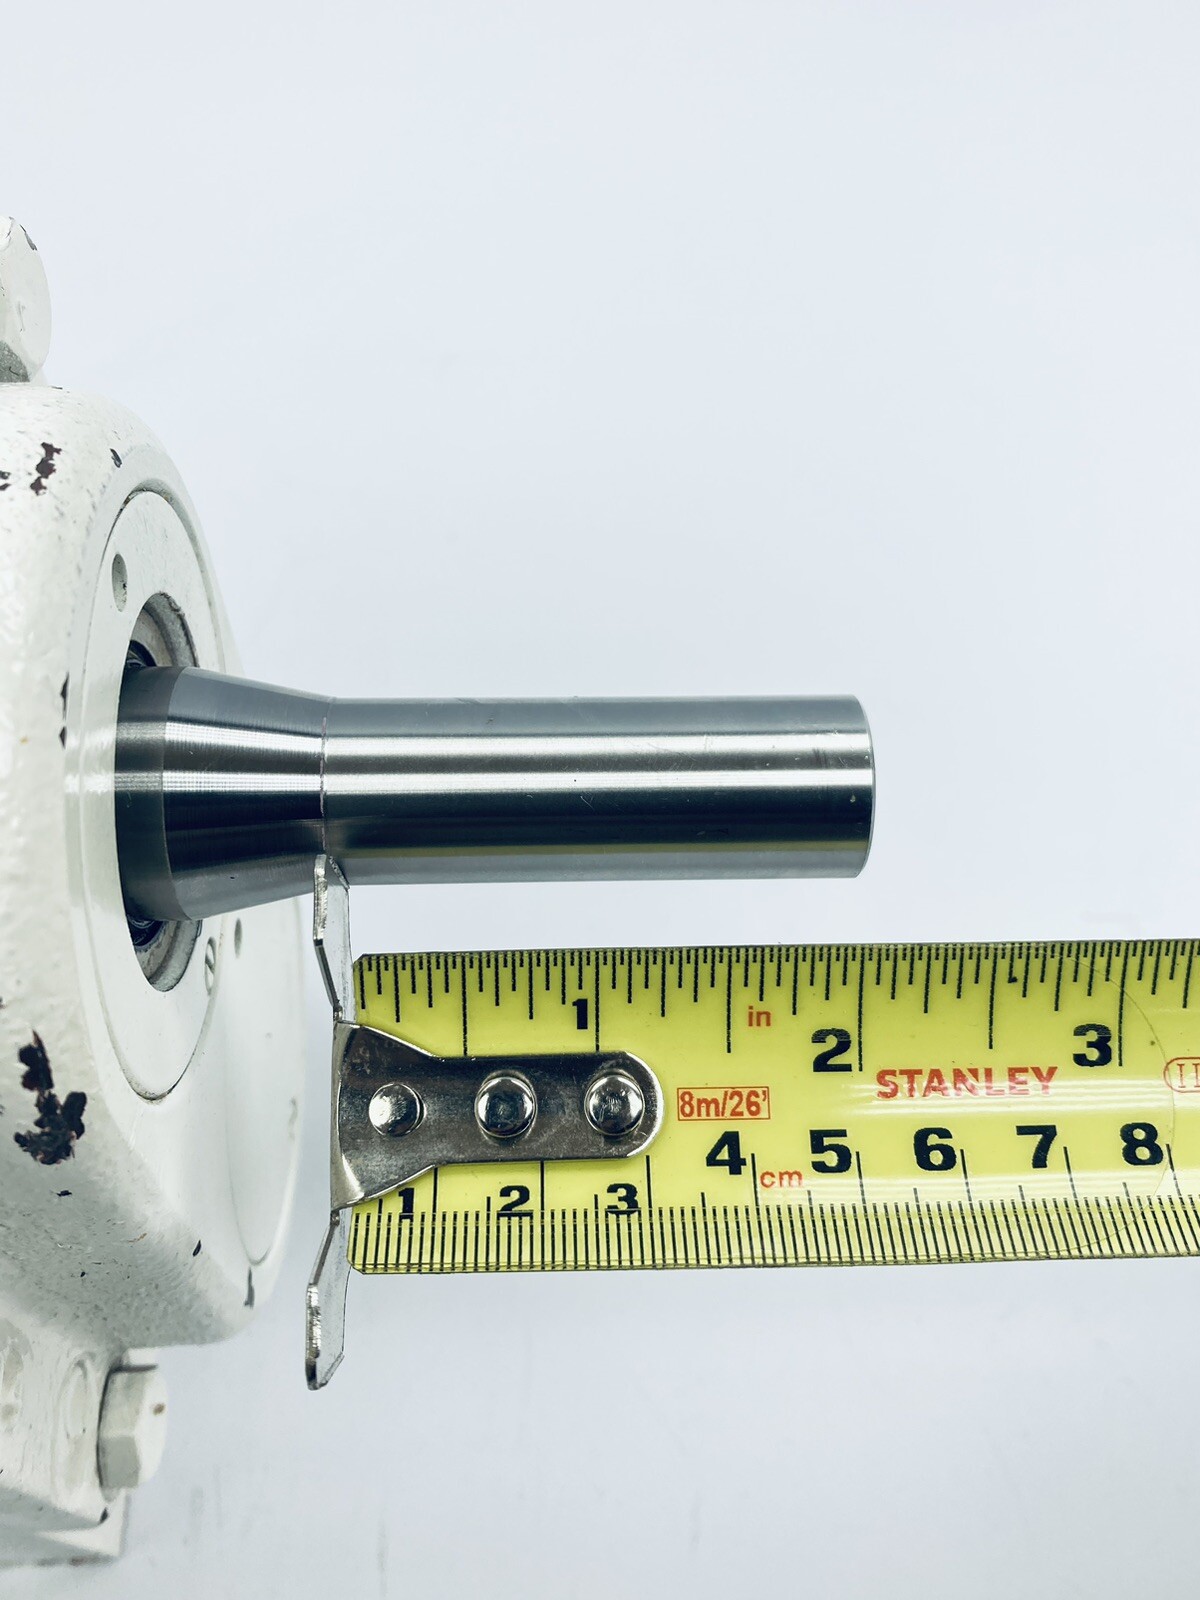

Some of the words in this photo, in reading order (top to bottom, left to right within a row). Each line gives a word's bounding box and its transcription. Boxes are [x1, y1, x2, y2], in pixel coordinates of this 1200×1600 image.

[572, 998, 589, 1030] 1
[747, 1006, 771, 1028] in
[811, 1027, 852, 1073] 2
[1072, 1024, 1113, 1067] 3
[876, 1066, 1058, 1099] STANLEY
[679, 1090, 768, 1118] 8m/26'
[705, 1131, 747, 1175] 4
[809, 1129, 852, 1174] 5
[913, 1127, 957, 1171] 6
[1016, 1125, 1058, 1169] 7
[1119, 1122, 1164, 1166] 8
[759, 1170, 803, 1188] cm
[398, 1187, 414, 1221] 1
[499, 1185, 532, 1217] 2
[606, 1183, 641, 1216] 3
